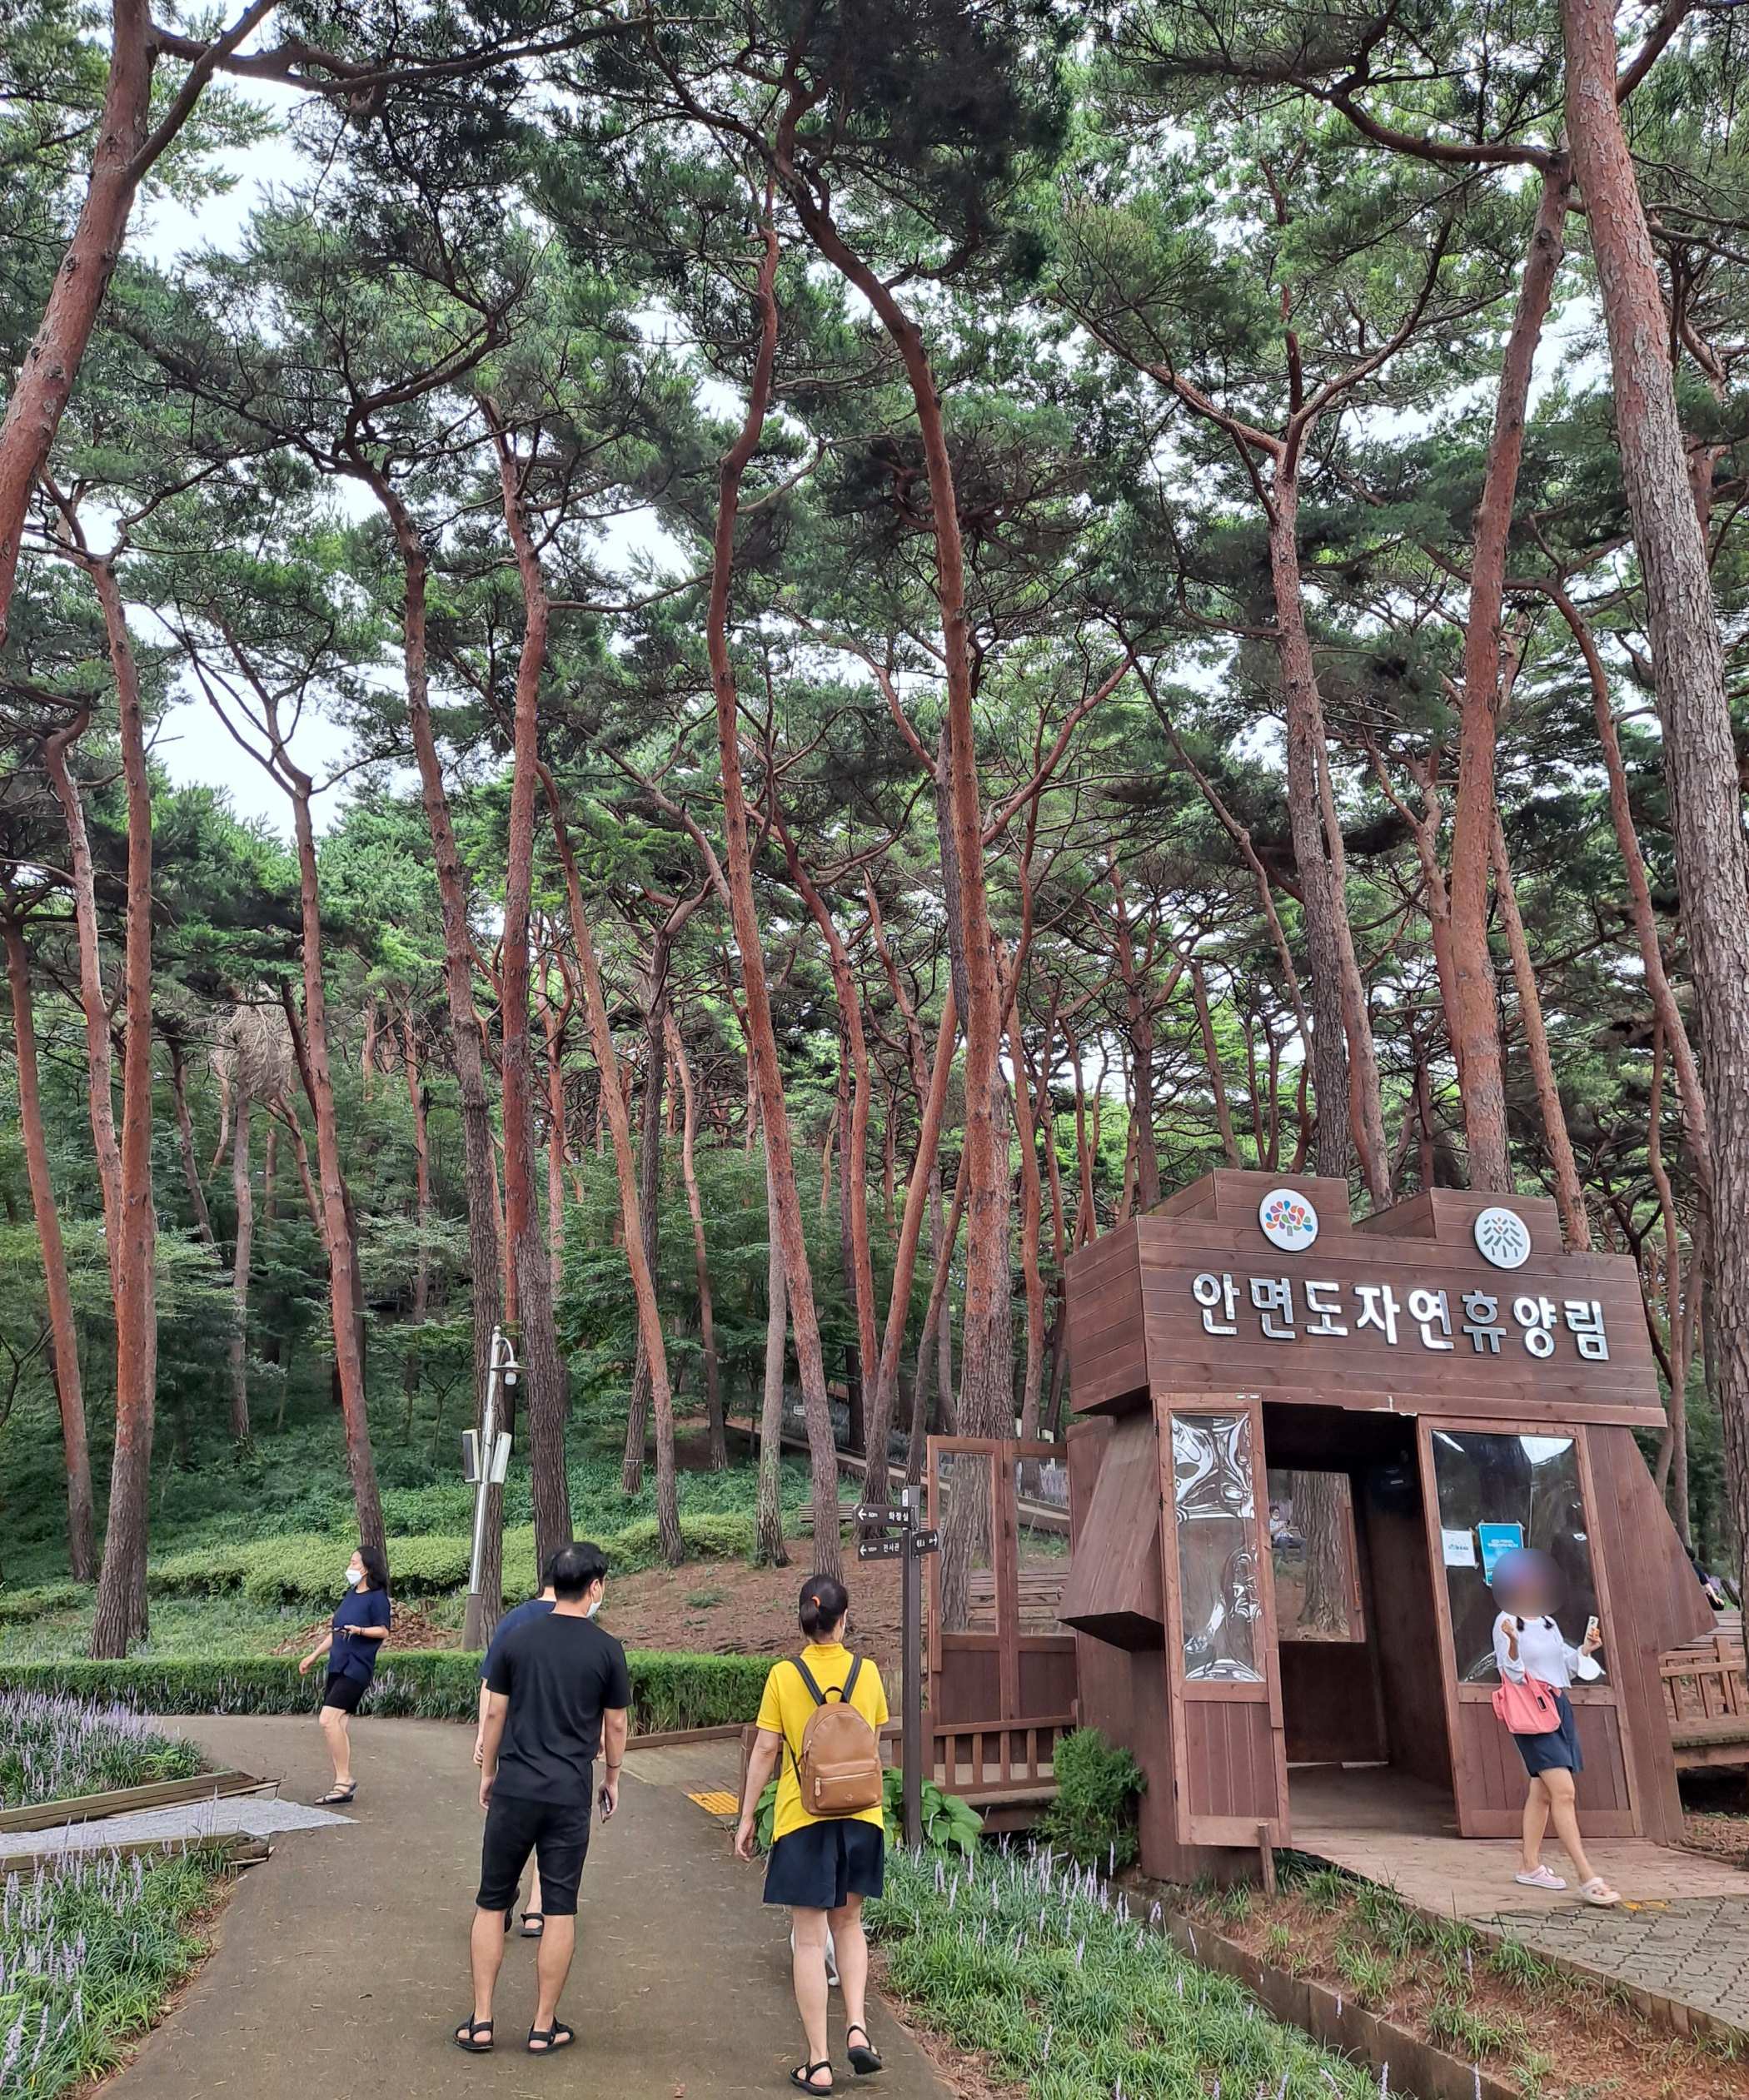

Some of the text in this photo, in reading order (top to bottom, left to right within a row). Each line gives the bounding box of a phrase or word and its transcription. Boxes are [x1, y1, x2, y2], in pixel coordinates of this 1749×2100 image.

[1191, 1272, 1610, 1361] 안면도자연휴양림
[889, 1511, 909, 1521] 화장실
[883, 1542, 899, 1552] 전시관
